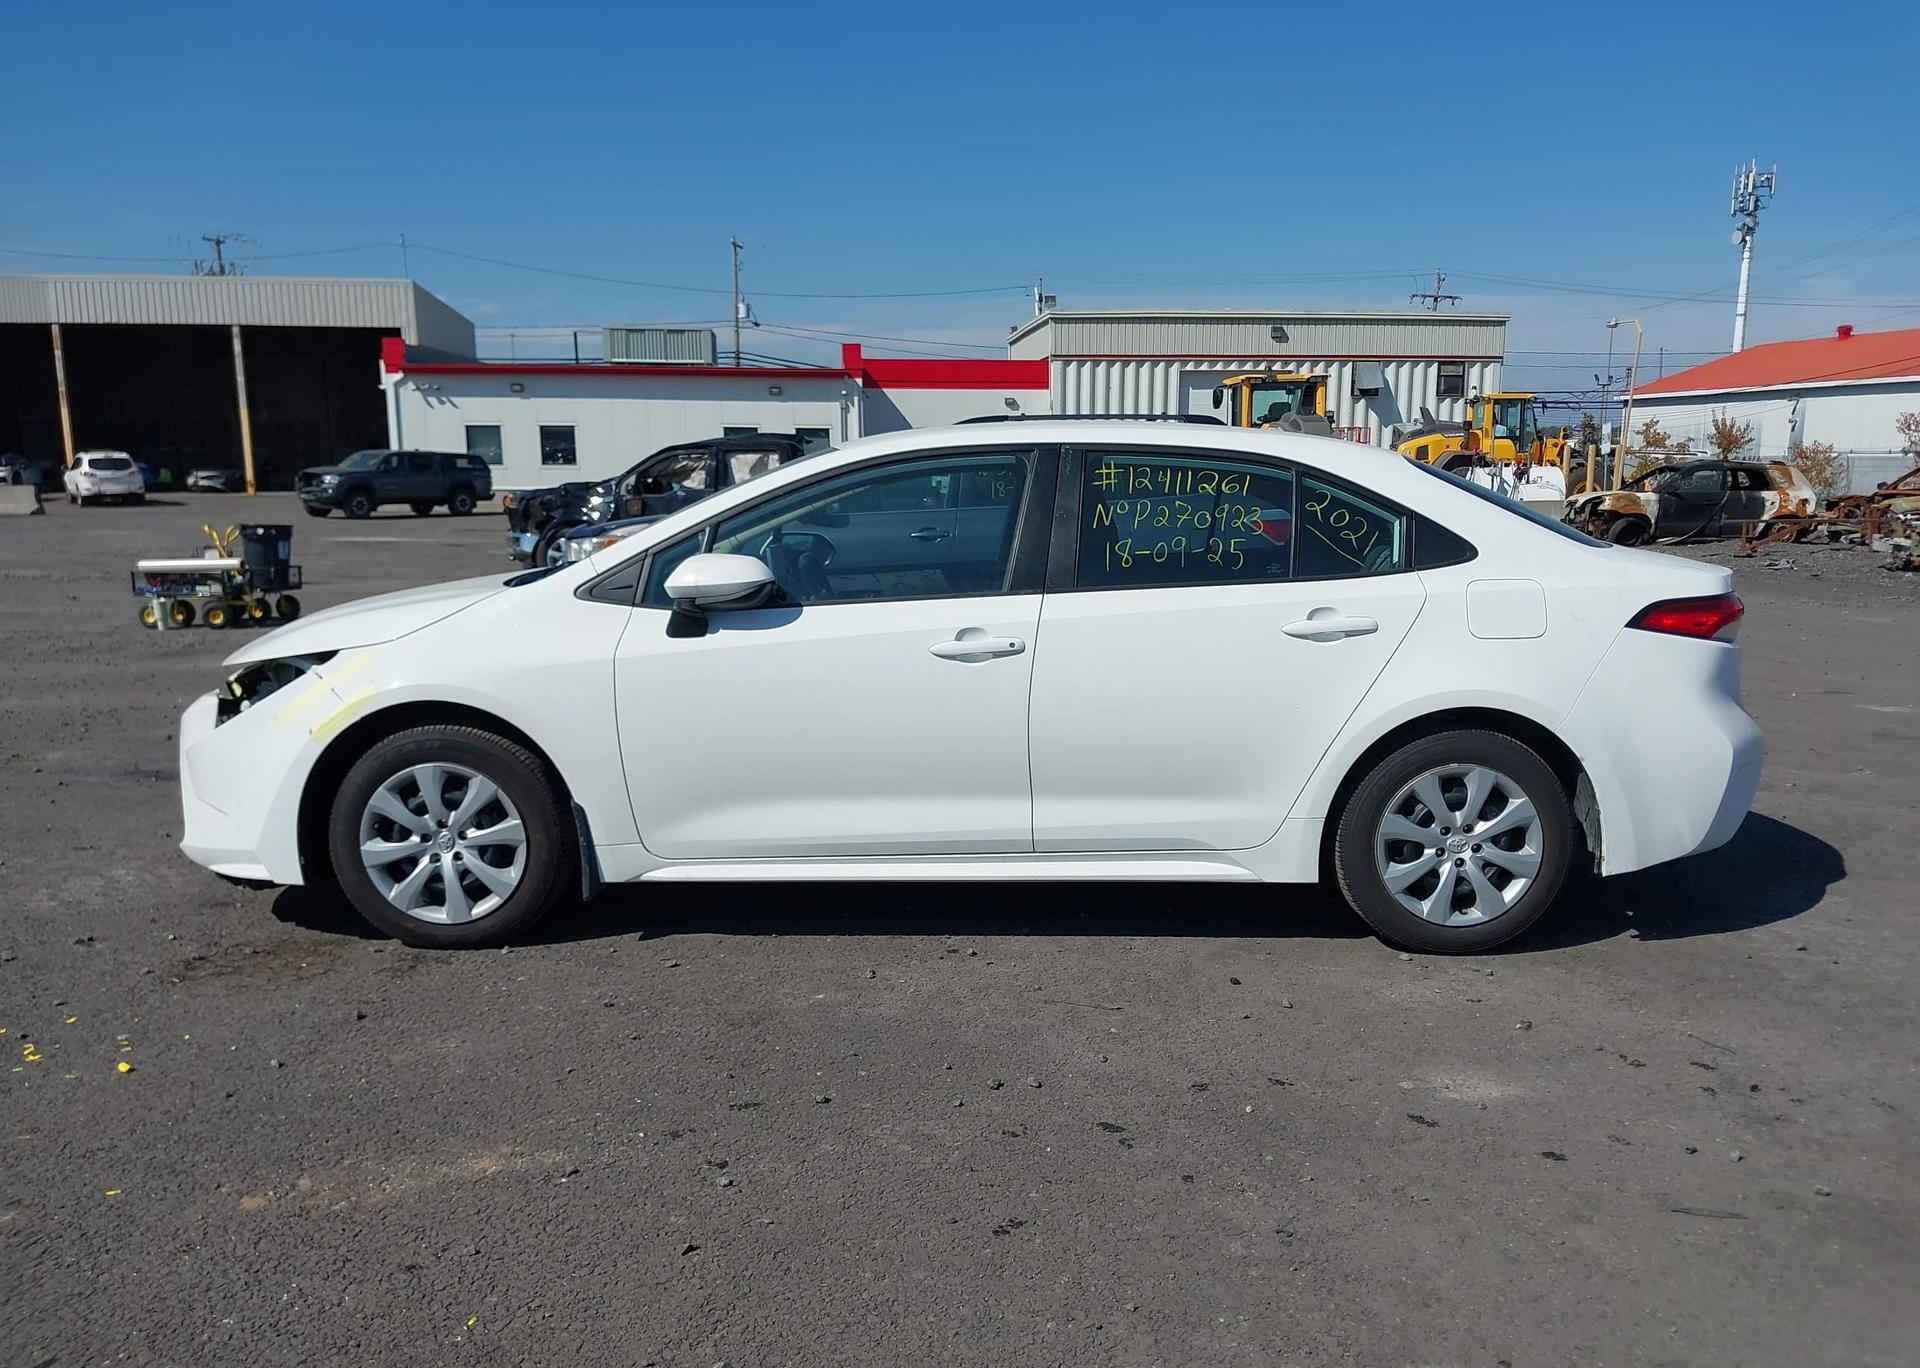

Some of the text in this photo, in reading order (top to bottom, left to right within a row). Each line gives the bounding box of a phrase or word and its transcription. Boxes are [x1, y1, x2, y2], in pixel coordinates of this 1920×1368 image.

[1092, 460, 1250, 496] #12411261
[1305, 489, 1379, 556] 2021
[1106, 536, 1247, 572] 18-09-25
